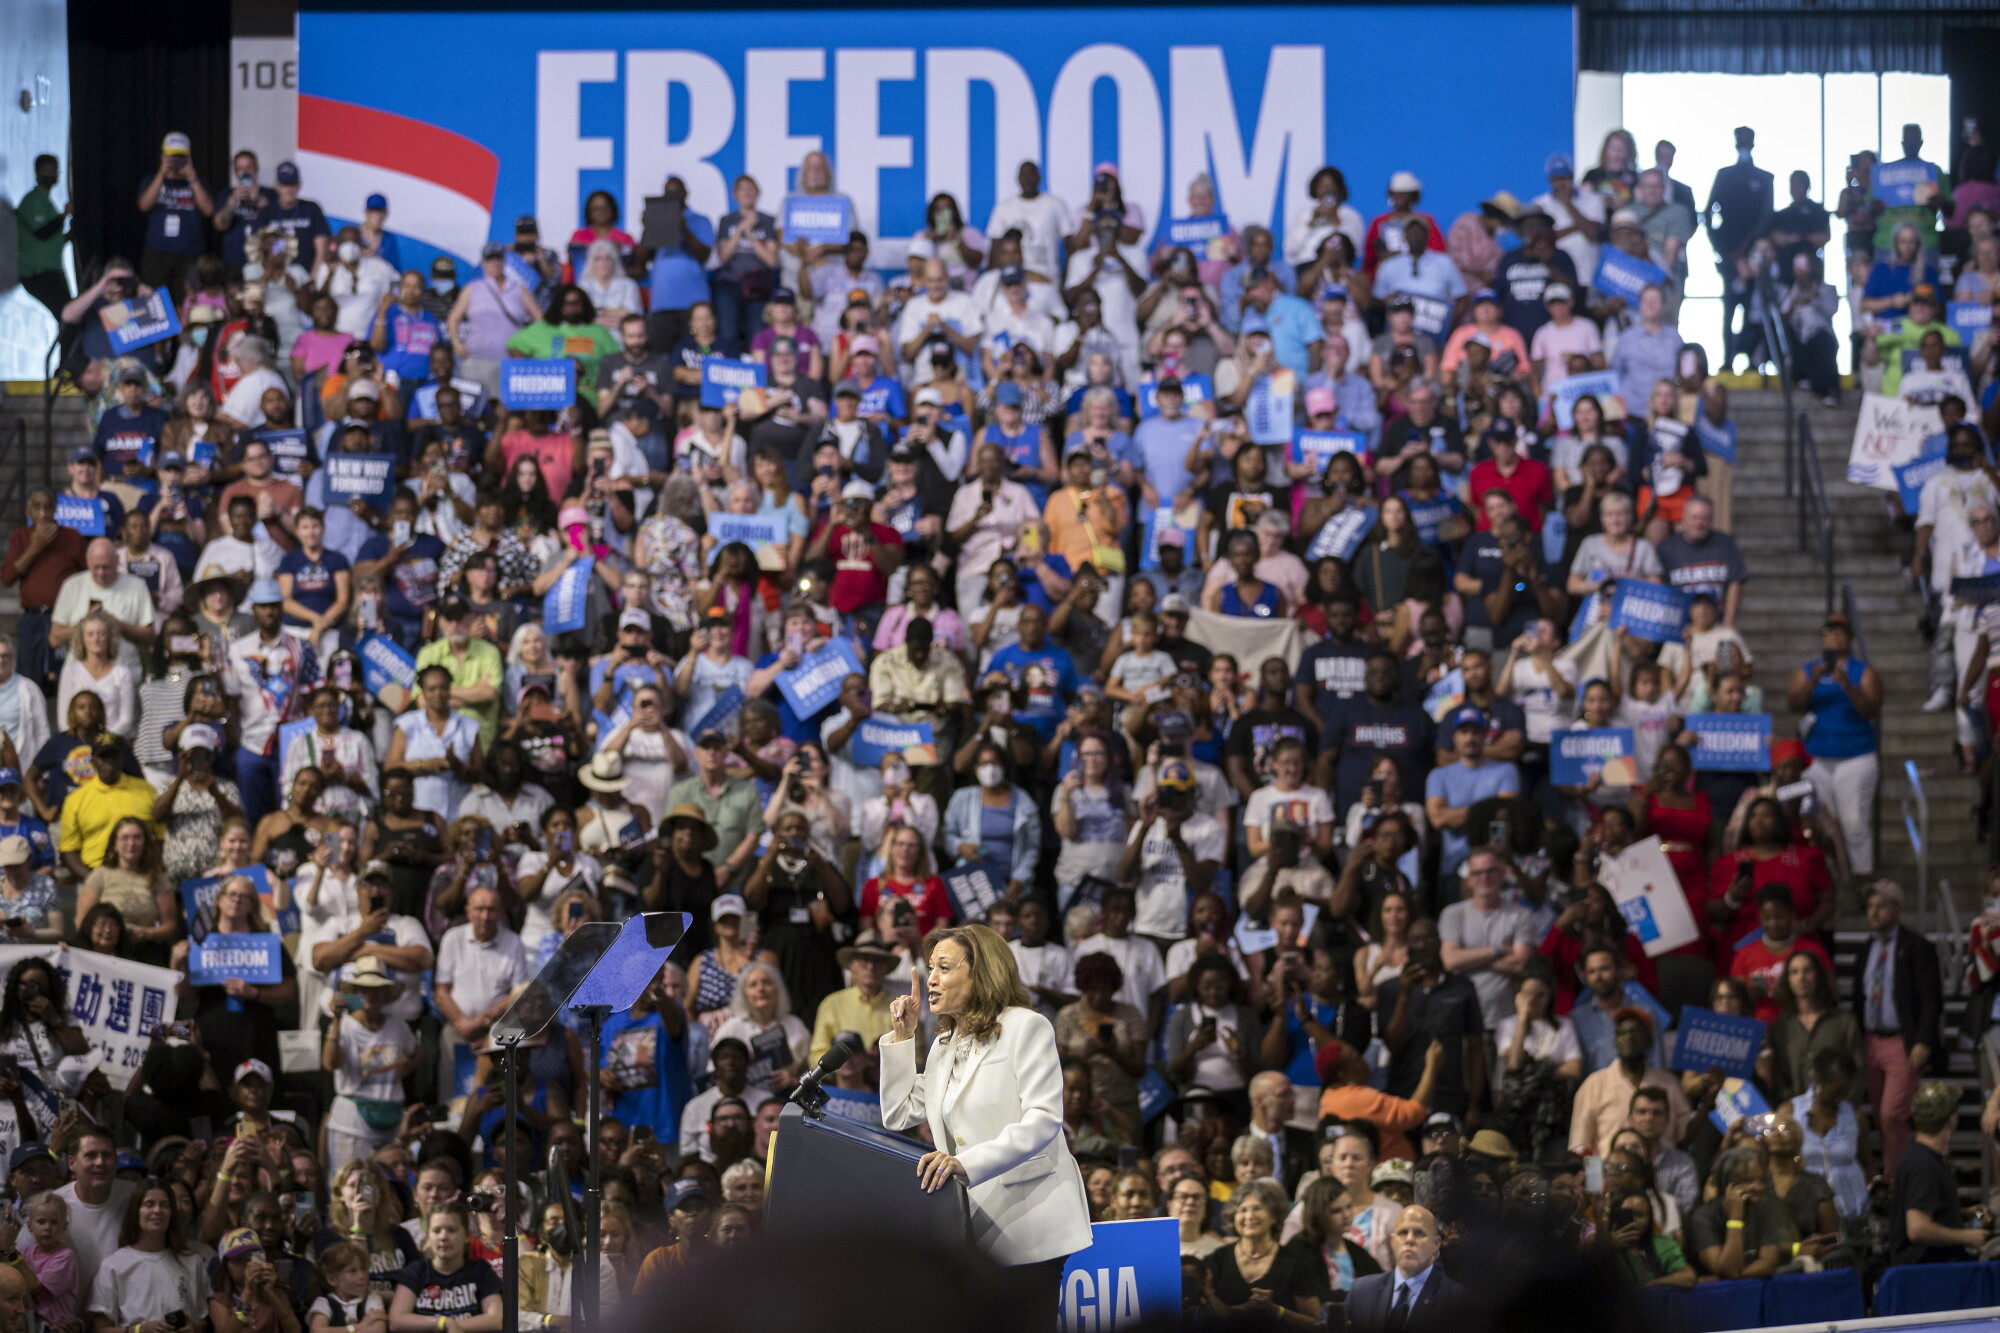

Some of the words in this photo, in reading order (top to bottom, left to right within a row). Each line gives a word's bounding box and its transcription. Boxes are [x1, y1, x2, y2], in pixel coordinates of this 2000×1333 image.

[535, 43, 1326, 270] FREEDOM
[509, 375, 566, 394] FREEDOM
[1620, 595, 1683, 626] FREEDOM
[201, 949, 268, 970] FREEDOM
[1684, 1026, 1752, 1062] FREEDOM
[1056, 1265, 1142, 1333] GIA
